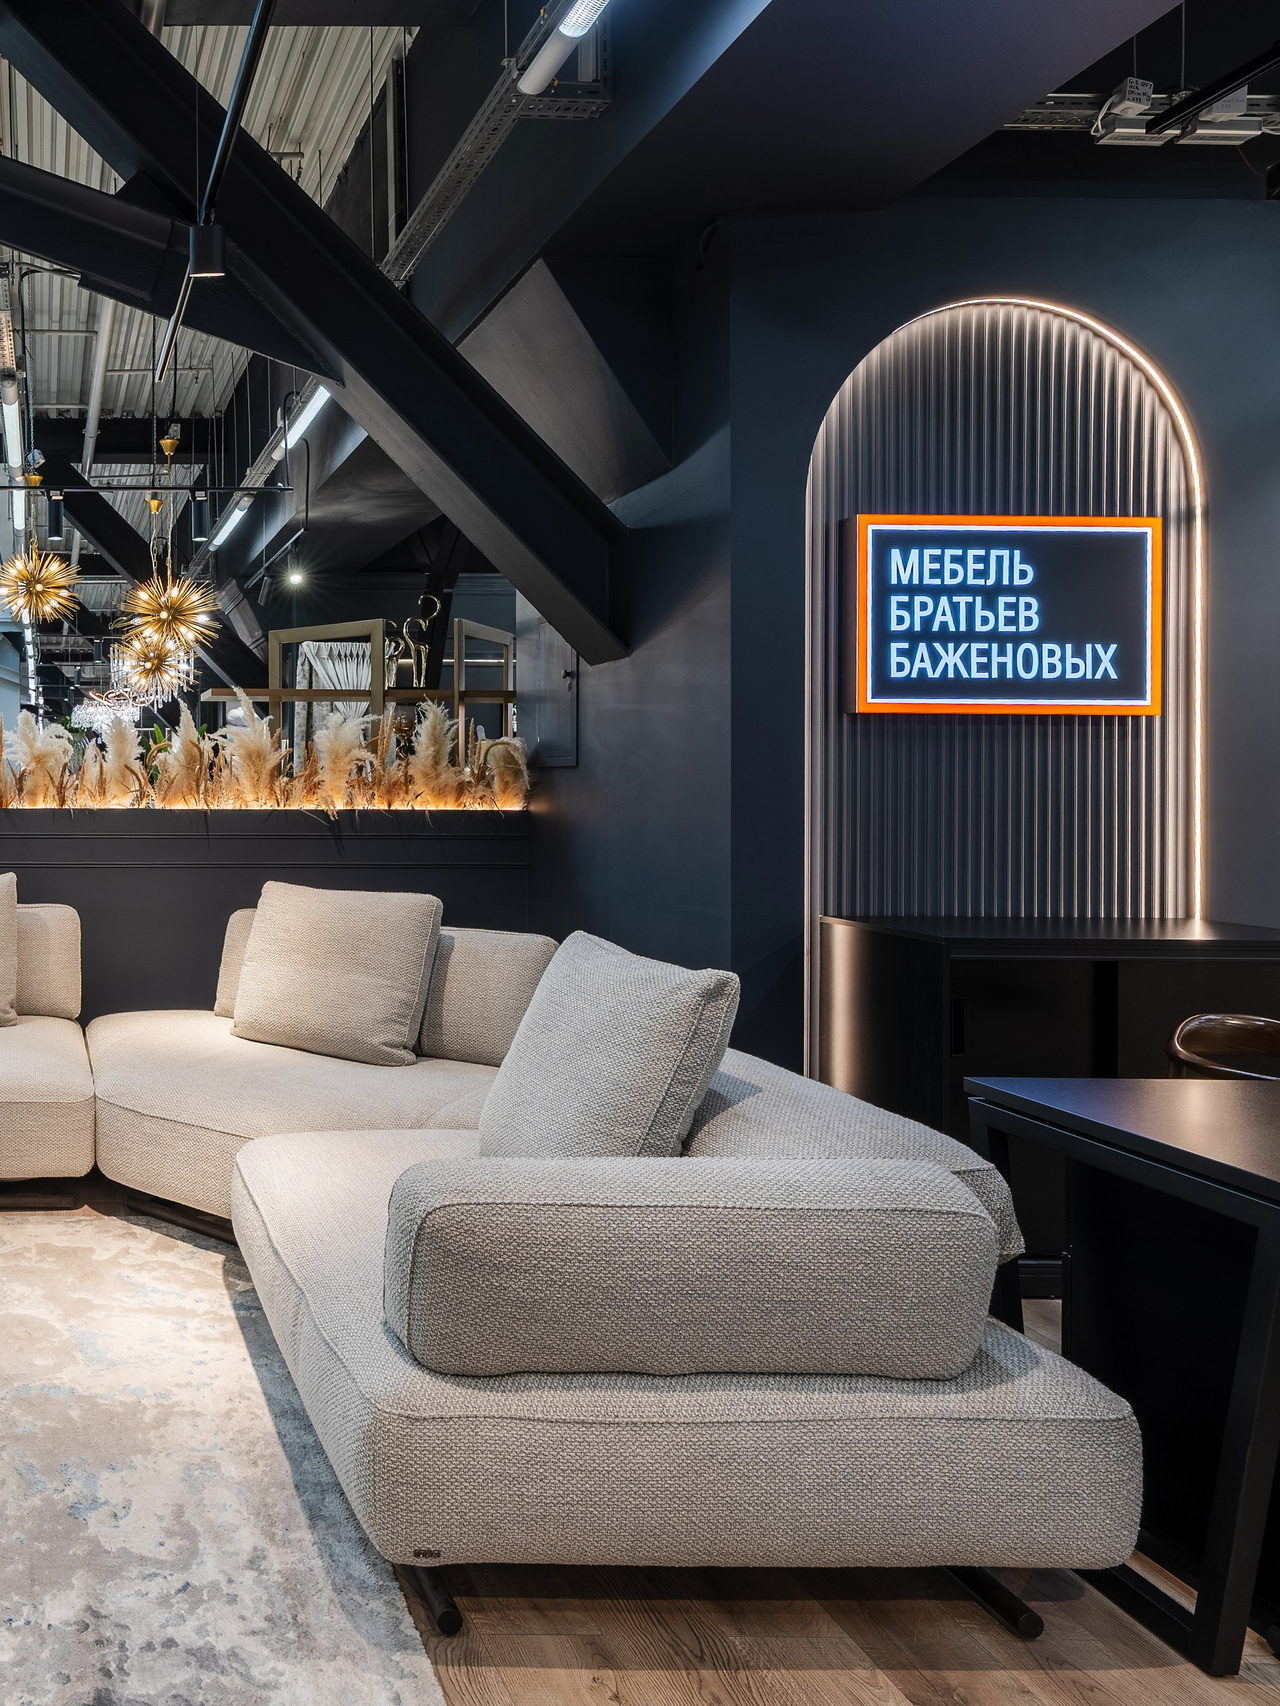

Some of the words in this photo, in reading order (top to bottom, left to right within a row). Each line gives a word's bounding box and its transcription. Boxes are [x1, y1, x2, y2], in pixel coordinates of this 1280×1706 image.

[889, 547, 1035, 586] МЕБЕЛЬ
[889, 595, 1040, 633] БРАТЬЕВ
[889, 641, 1118, 680] БАЖЕНОВЫХ
